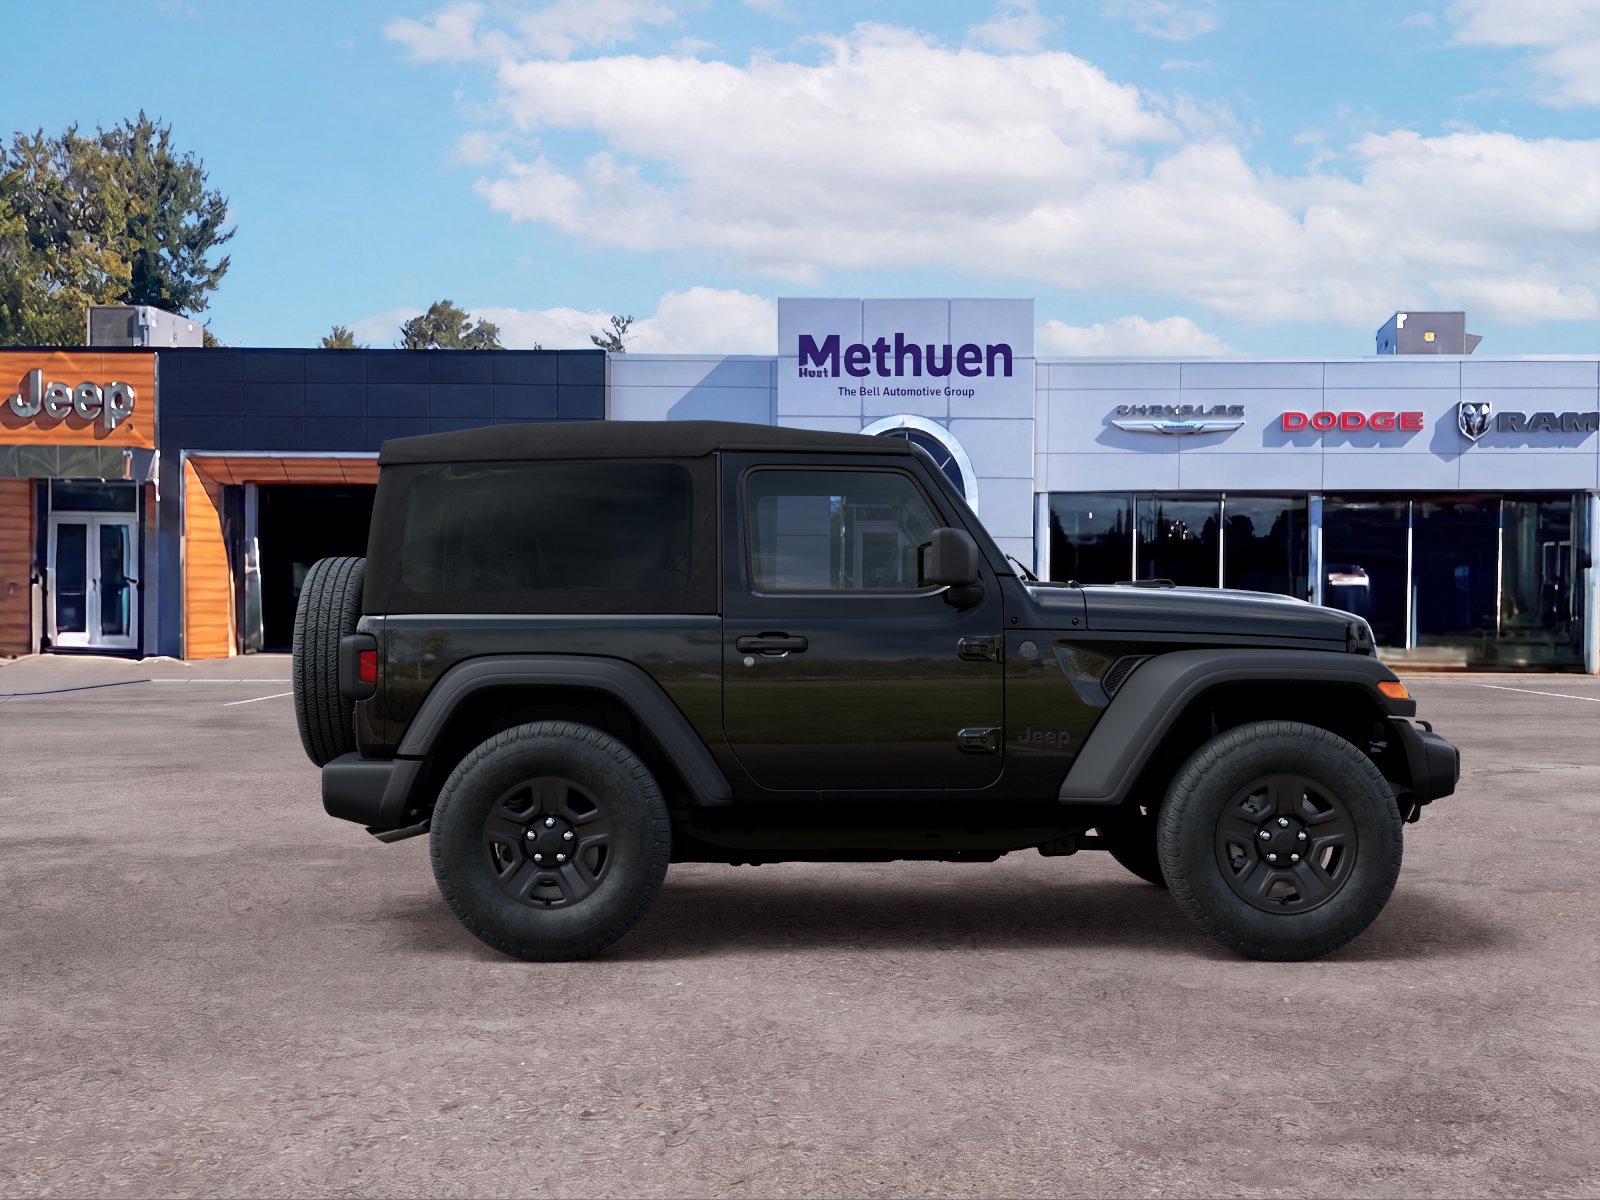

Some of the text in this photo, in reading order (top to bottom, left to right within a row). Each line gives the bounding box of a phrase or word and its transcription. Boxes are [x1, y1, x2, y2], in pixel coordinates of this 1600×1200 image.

[798, 333, 1013, 378] Methuen
[9, 368, 135, 429] Jeep
[838, 387, 975, 399] The Bell Automotive Group
[1282, 411, 1424, 431] DODGE
[1498, 411, 1598, 432] RAM
[1017, 726, 1072, 748] Jeep
